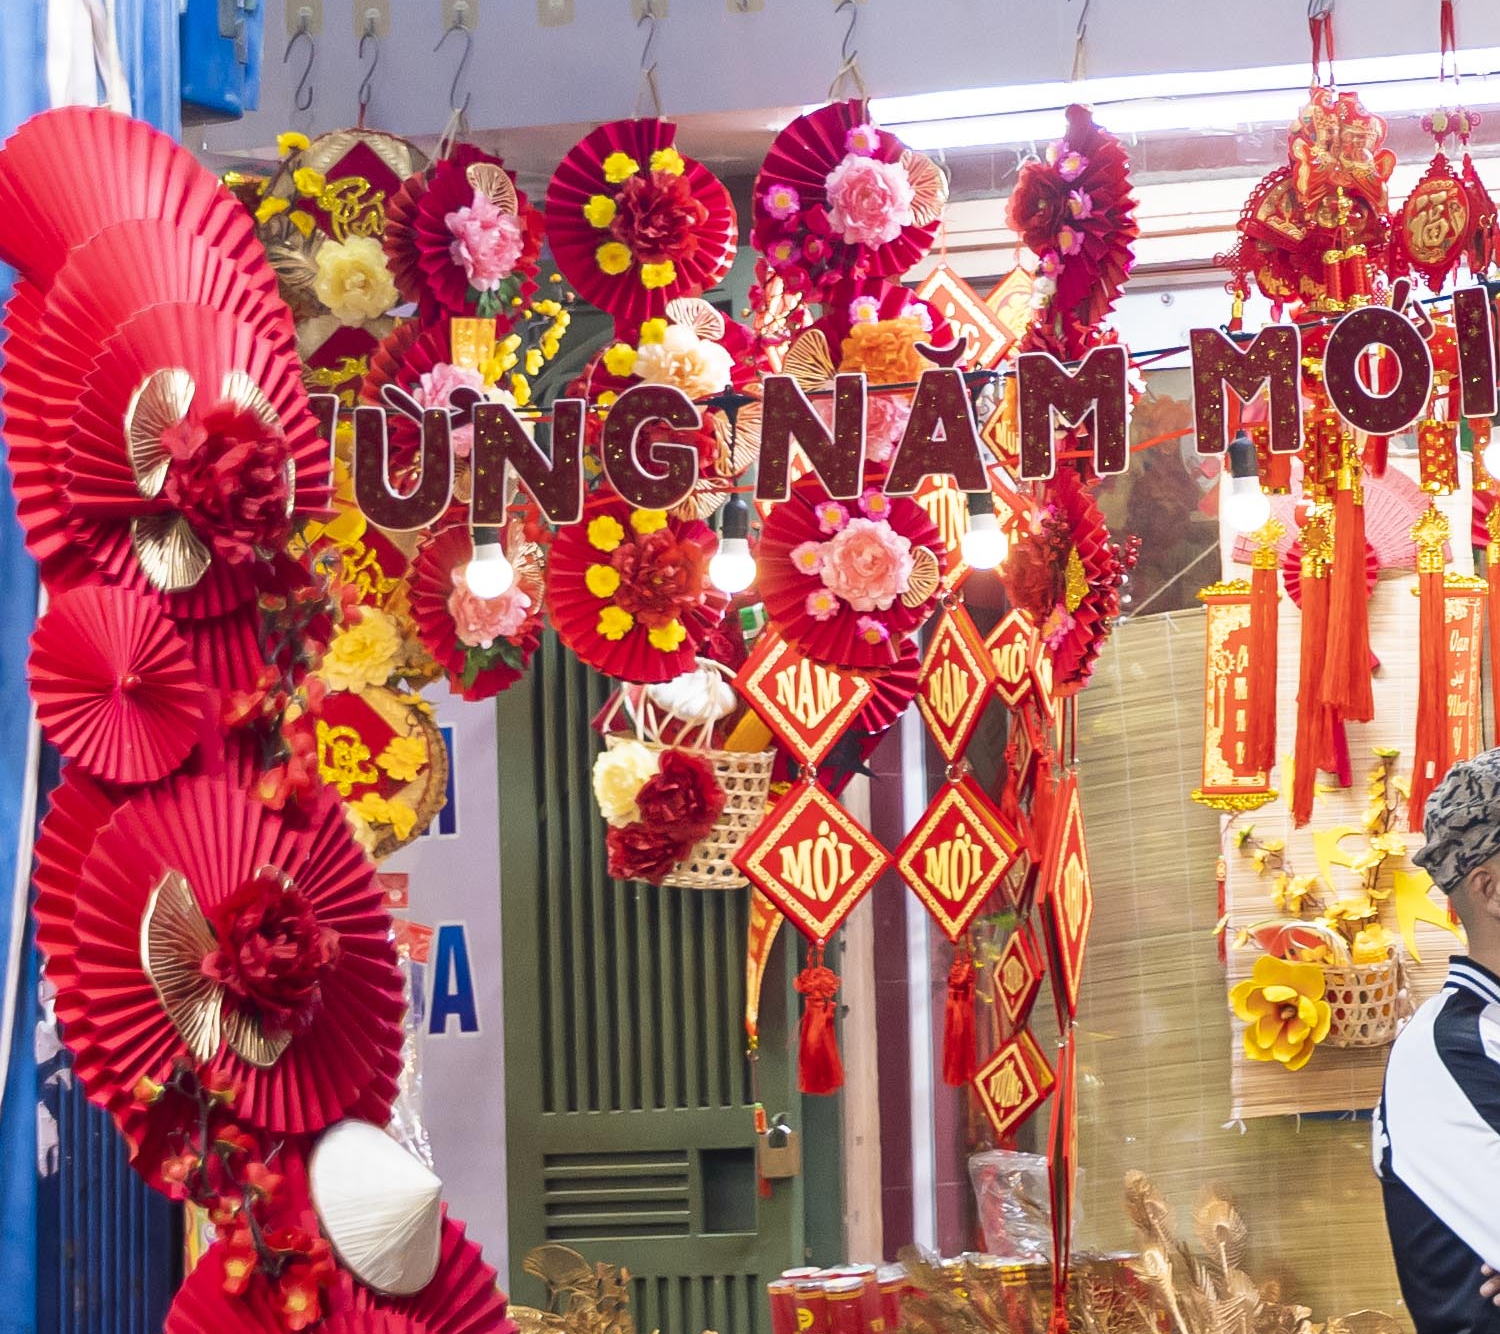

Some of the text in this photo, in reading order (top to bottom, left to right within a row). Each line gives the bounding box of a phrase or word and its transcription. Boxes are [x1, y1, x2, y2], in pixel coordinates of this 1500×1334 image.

[755, 335, 1130, 503] NĂM
[1188, 277, 1498, 457] MỚI
[779, 819, 854, 903] MỚI
[924, 822, 983, 903] MỚI
